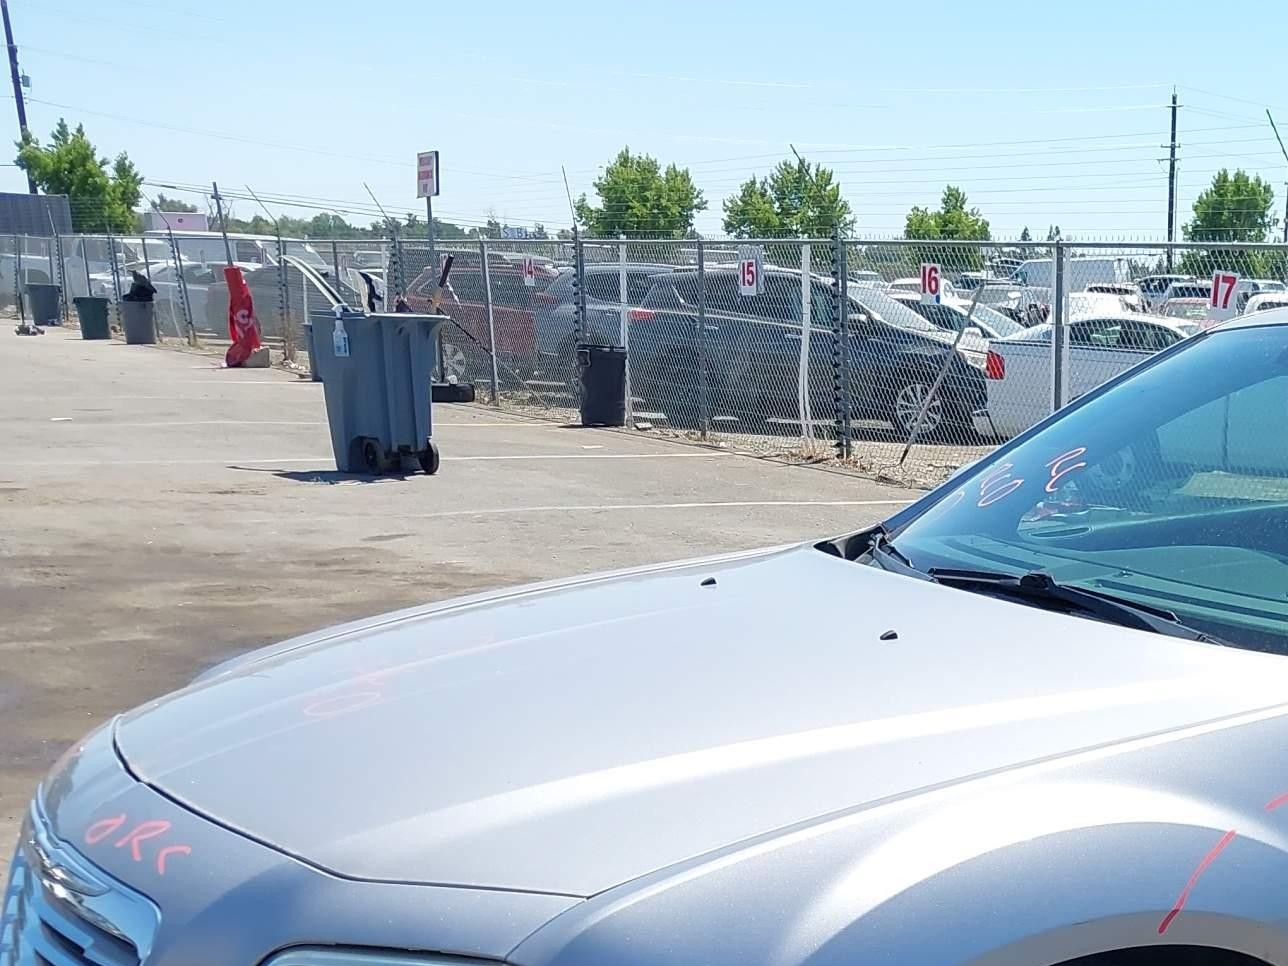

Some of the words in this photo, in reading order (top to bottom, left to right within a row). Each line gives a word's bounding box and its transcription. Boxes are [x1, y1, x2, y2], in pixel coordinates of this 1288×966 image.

[741, 261, 756, 287] 15
[922, 265, 939, 296] 16
[1212, 273, 1237, 310] 17
